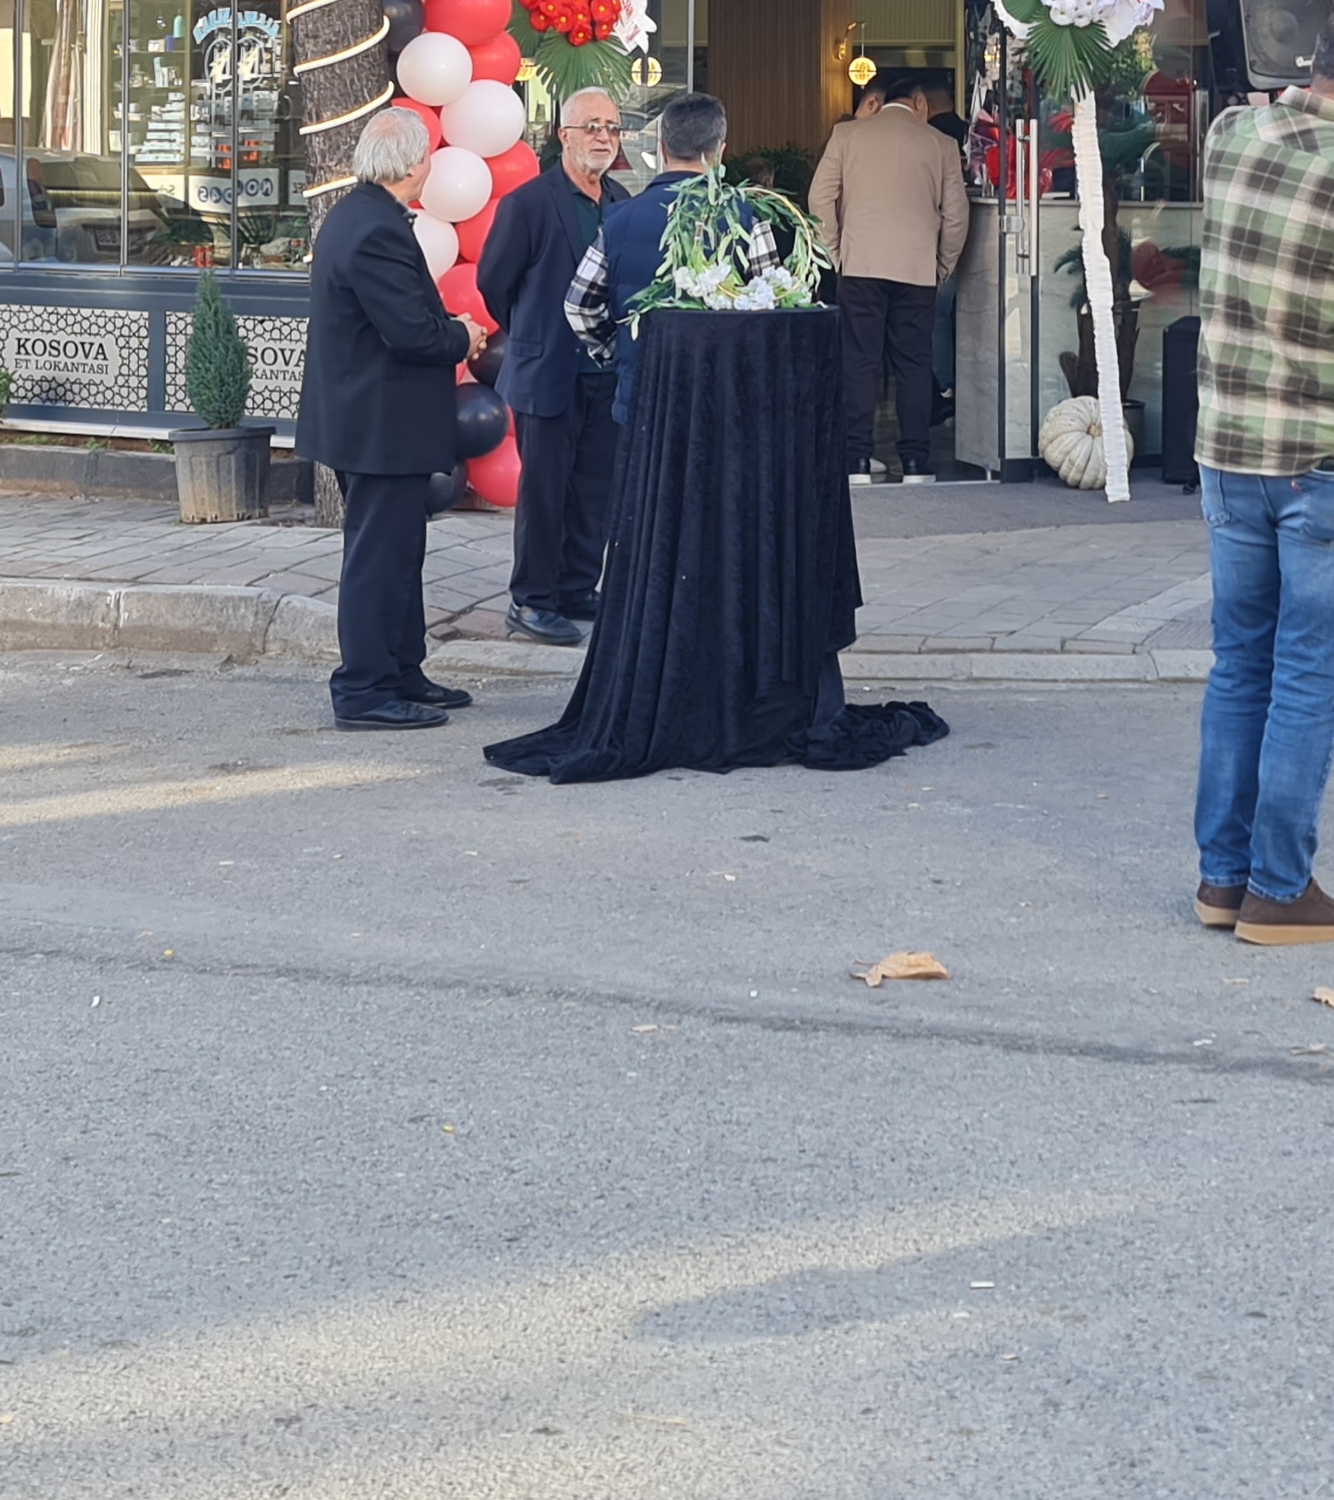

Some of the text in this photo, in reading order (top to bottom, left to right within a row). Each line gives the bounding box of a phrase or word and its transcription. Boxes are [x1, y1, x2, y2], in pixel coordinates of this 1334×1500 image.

[14, 337, 109, 362] KOSOVA
[247, 345, 305, 367] SOVA
[14, 358, 109, 376] ET LOKANTASI
